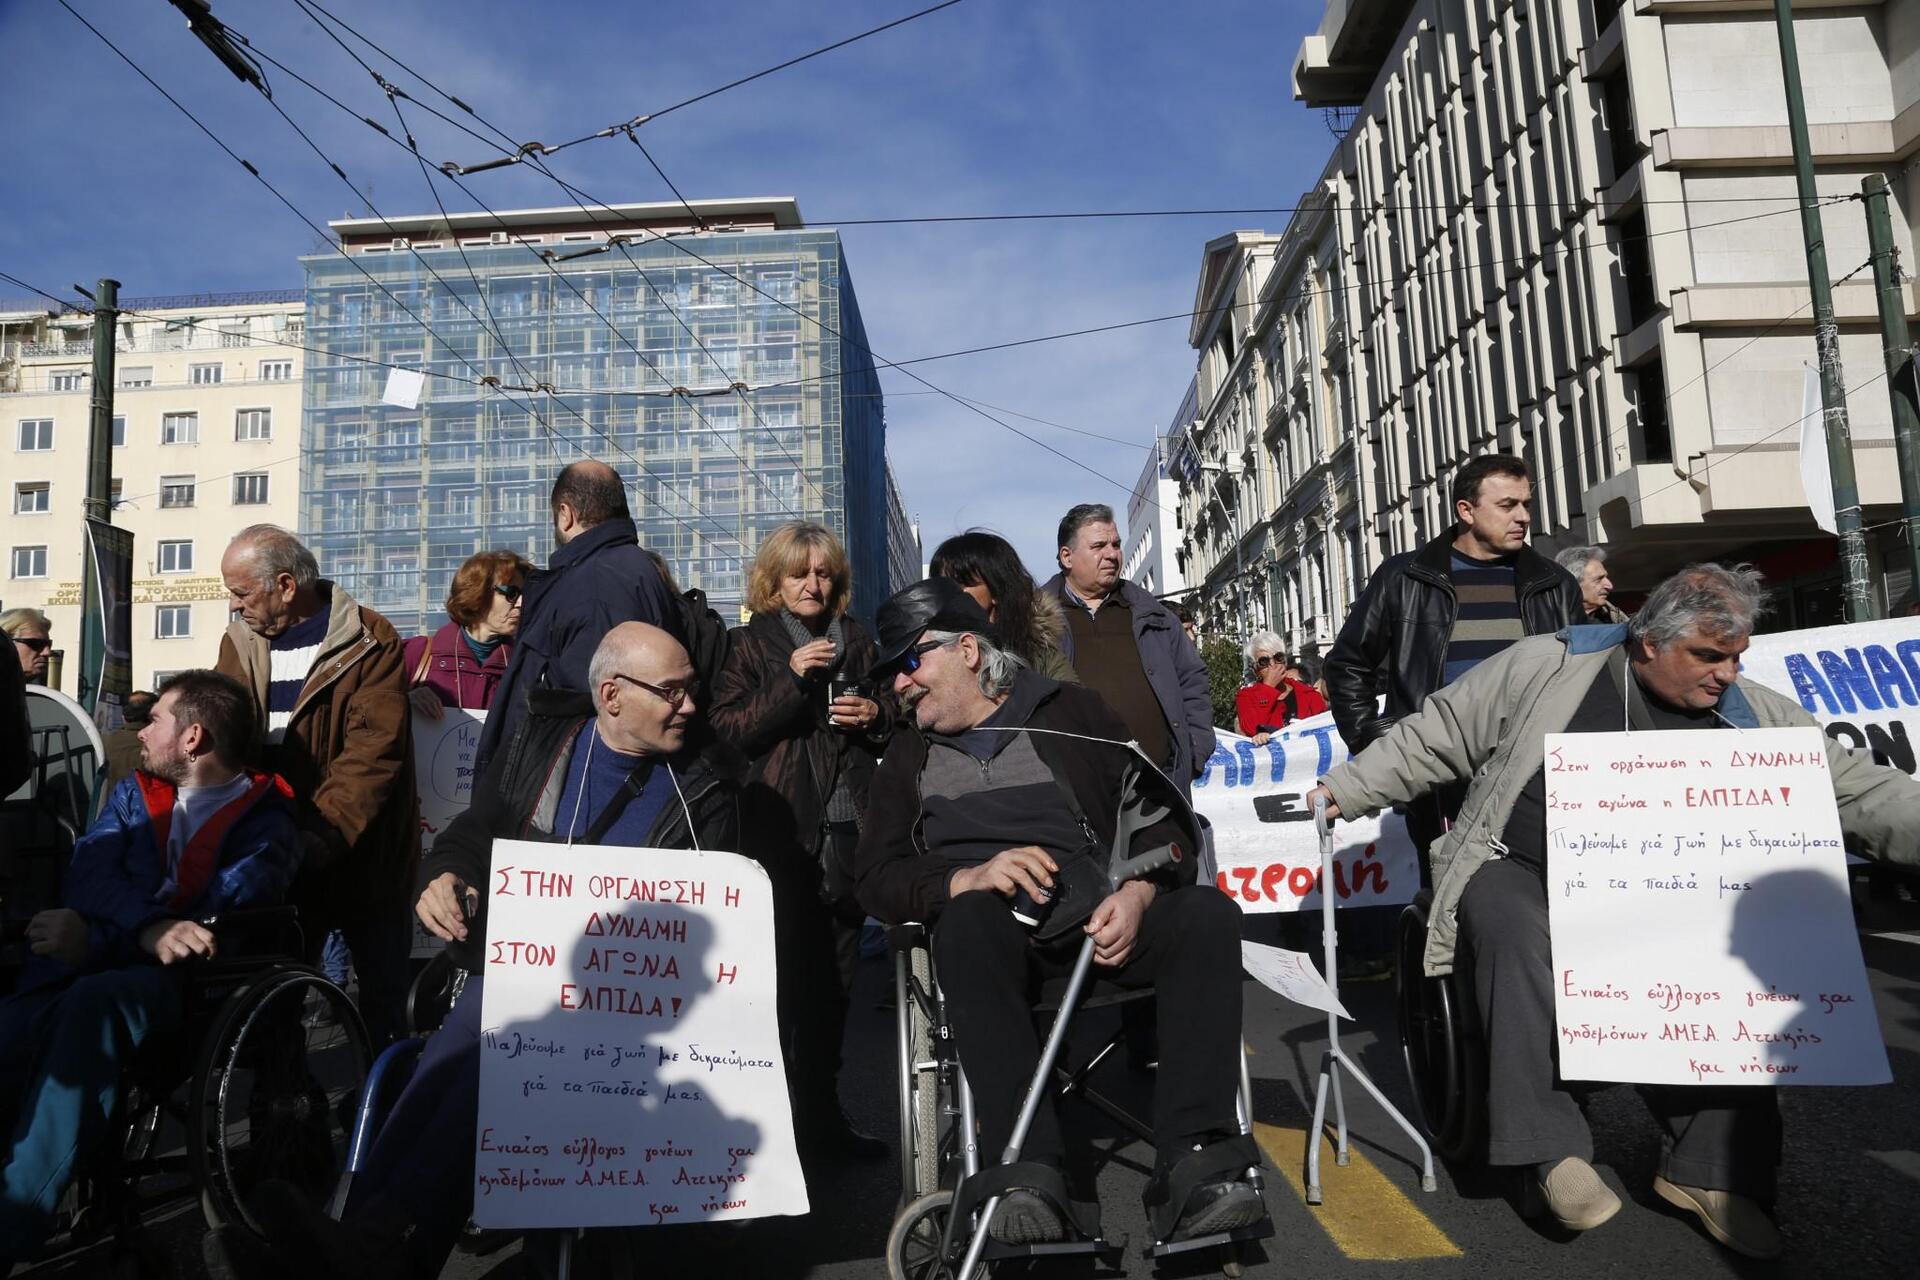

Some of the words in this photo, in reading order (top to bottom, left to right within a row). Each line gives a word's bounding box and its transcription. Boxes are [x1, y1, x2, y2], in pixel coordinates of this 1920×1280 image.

[1598, 793, 1648, 812] αγώνα
[1721, 833, 1742, 856] με
[496, 866, 574, 898] ΣΤΗΝ
[588, 875, 705, 905] ΟΡΓΑΝΩΣΗ
[725, 886, 741, 908] Η
[1216, 842, 1389, 902] ιτροπή
[1608, 878, 1628, 890] τα
[584, 911, 687, 944] ΔΥΝΑΜΗ
[489, 940, 556, 967] ΣΤΟΝ
[583, 947, 679, 980] ΑΓΩΝΑ
[717, 962, 738, 985] Η
[560, 983, 682, 1018] ΕΛΠΙΔΑ!
[658, 1045, 679, 1067] με
